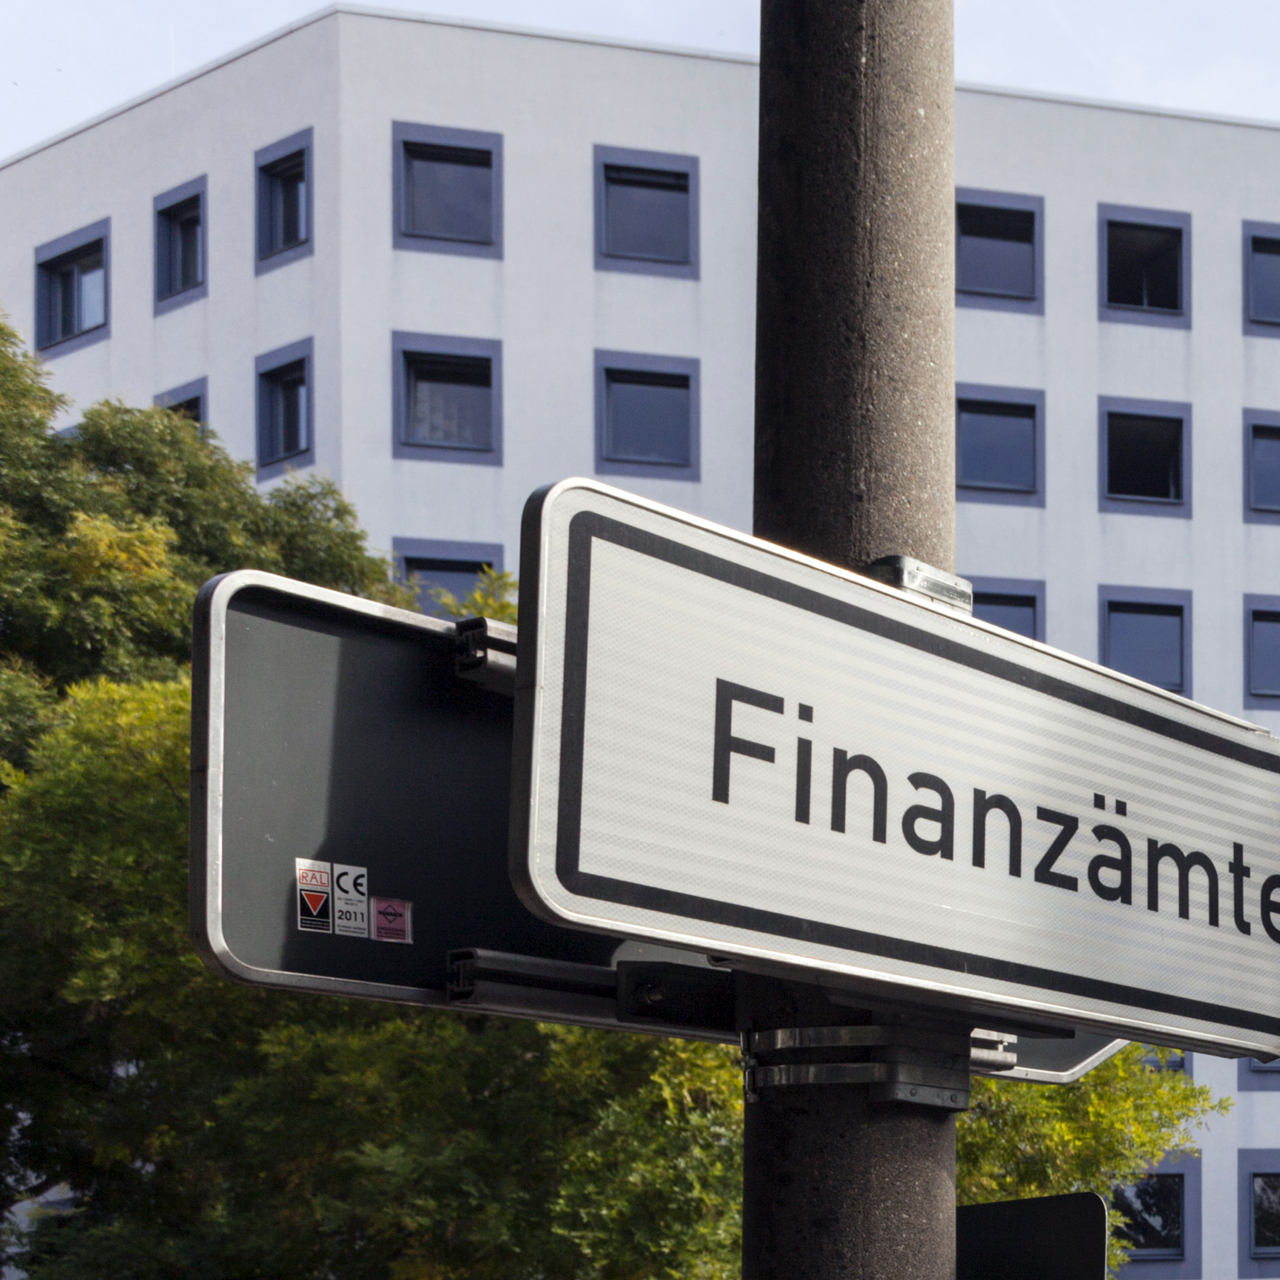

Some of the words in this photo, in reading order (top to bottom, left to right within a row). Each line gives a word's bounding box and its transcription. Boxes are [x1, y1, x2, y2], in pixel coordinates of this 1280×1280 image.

[301, 871, 327, 885] RAL
[335, 871, 366, 897] CE
[337, 909, 365, 923] 2011
